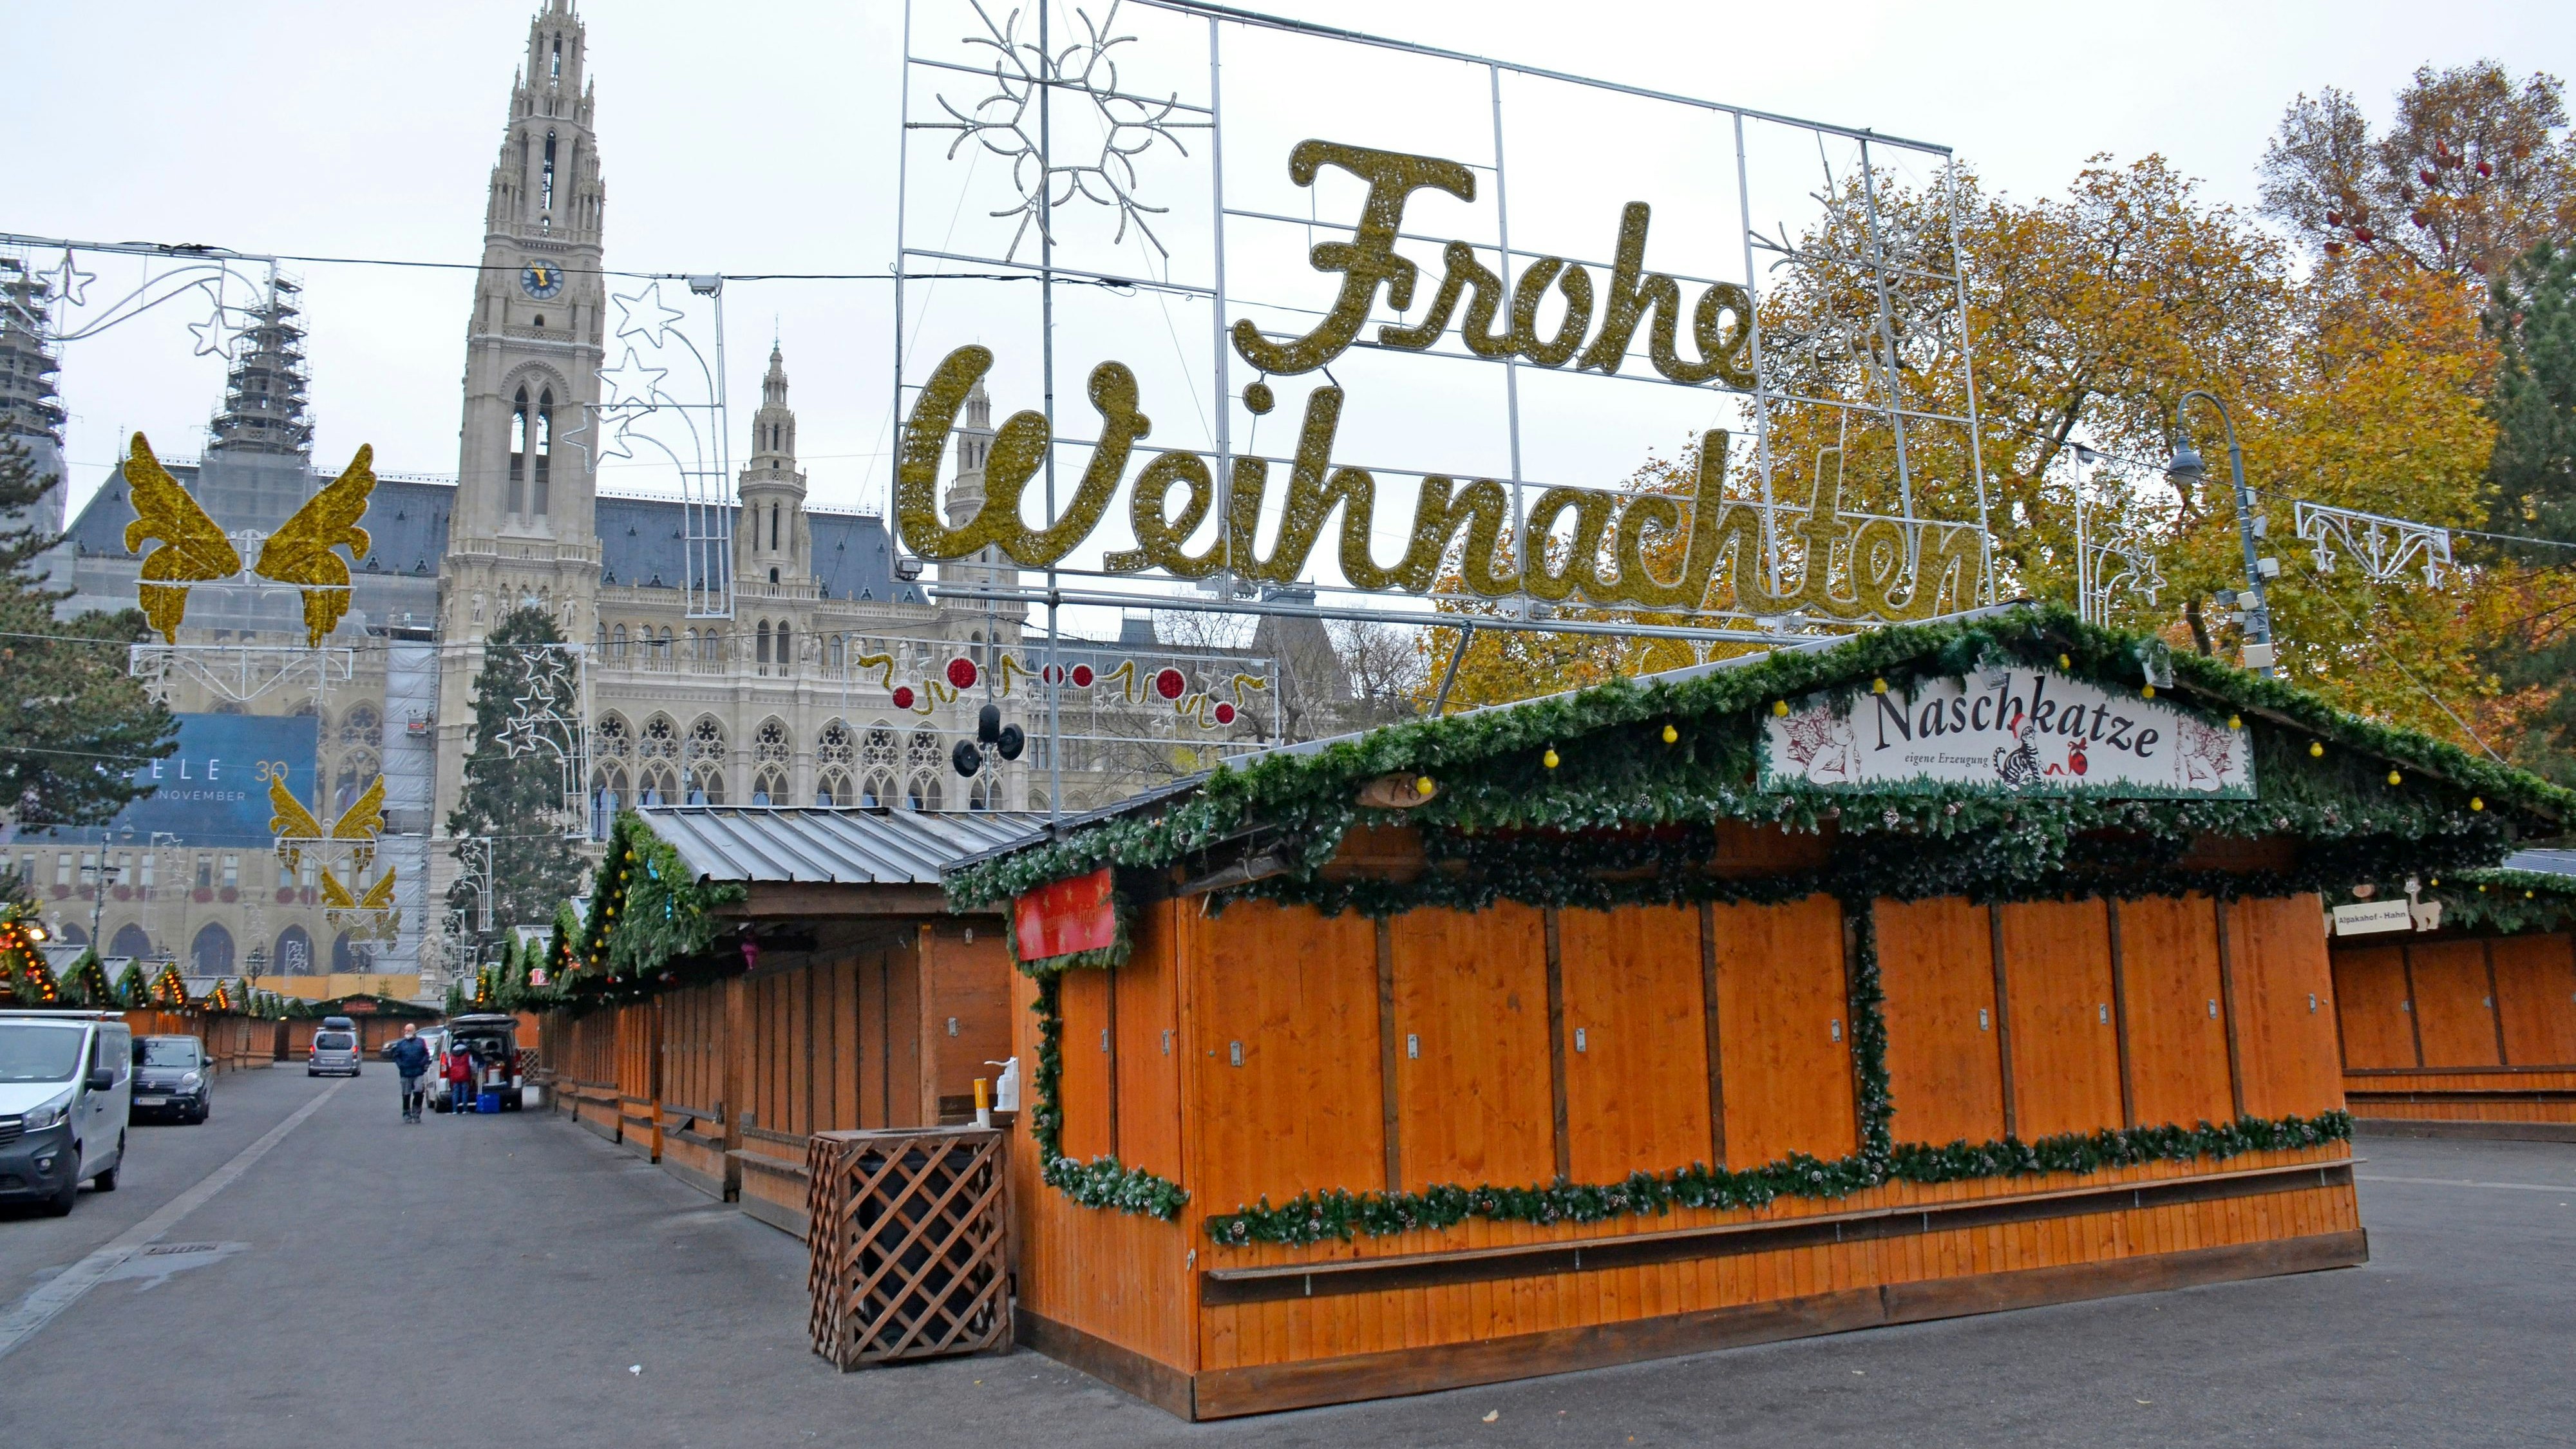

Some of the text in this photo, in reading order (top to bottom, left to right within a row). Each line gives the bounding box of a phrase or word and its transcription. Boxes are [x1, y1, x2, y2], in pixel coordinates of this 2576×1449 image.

[1232, 138, 1758, 390] Frohe
[896, 345, 1985, 623] Weihnachten
[1871, 672, 2159, 758] Naschkatze
[254, 761, 289, 782] 30
[1904, 752, 1989, 768] eigene Erzeugung
[2339, 913, 2378, 925] Alpakahof
